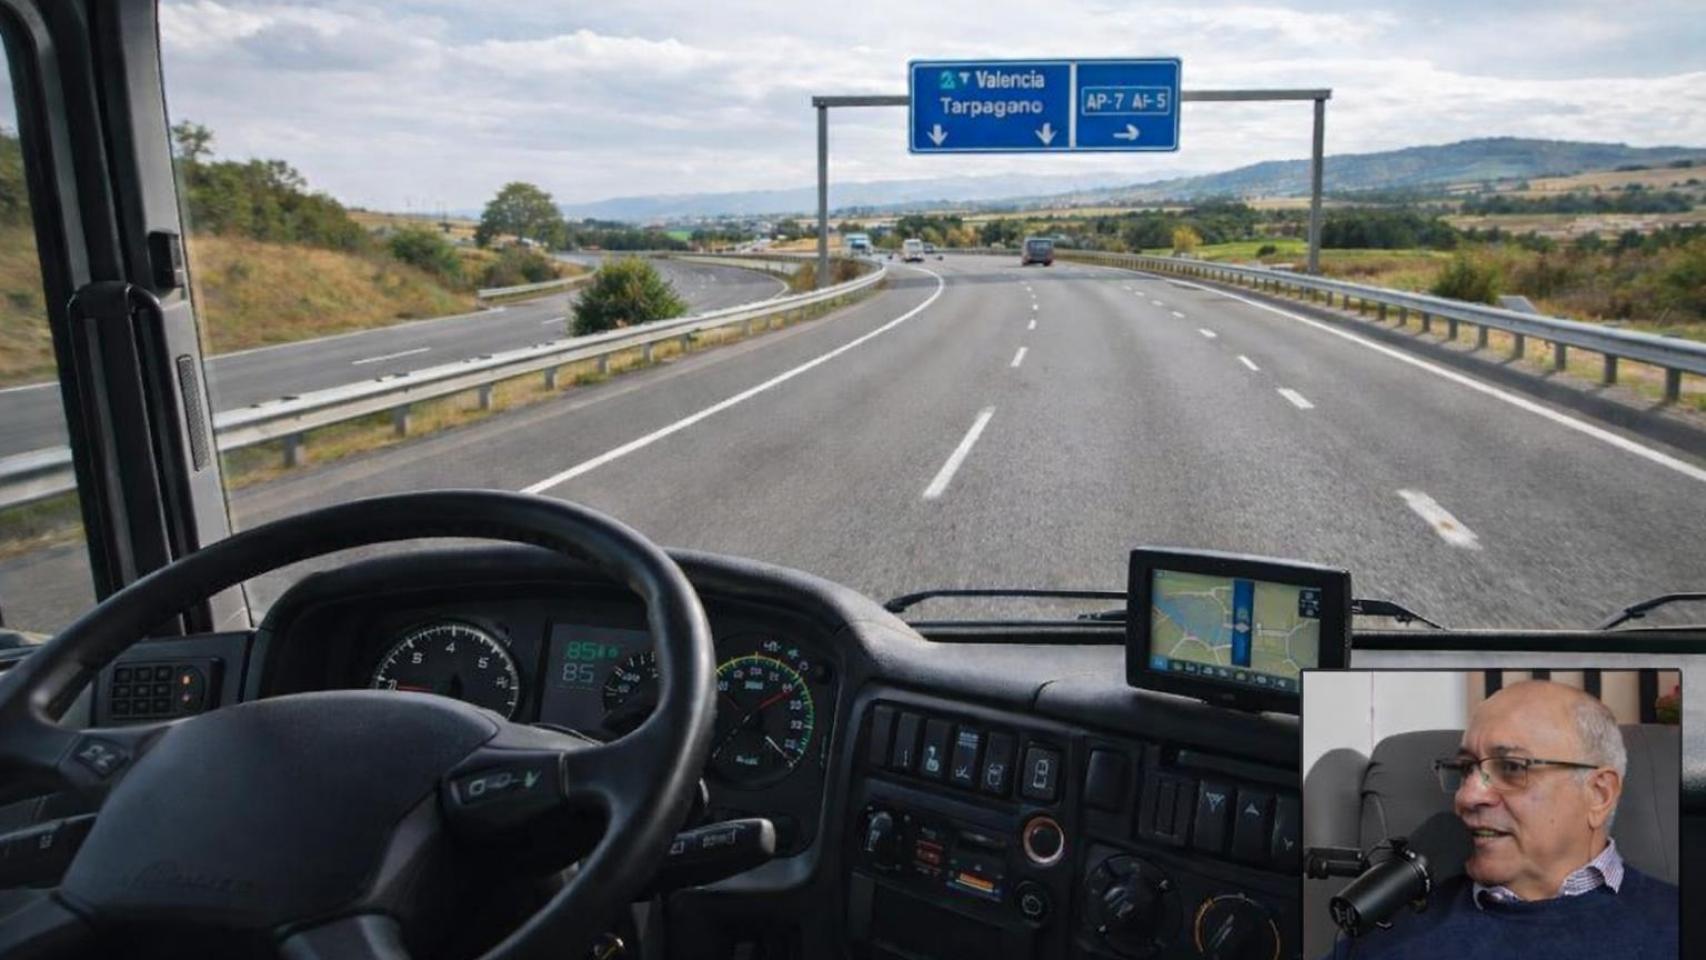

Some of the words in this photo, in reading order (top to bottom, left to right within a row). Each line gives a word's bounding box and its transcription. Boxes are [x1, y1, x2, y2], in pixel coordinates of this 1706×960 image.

[976, 70, 1045, 89] Valencia
[940, 97, 1044, 118] Tarpagano
[1086, 92, 1124, 110] AP-7
[445, 642, 456, 654] 4
[562, 663, 595, 683] 85
